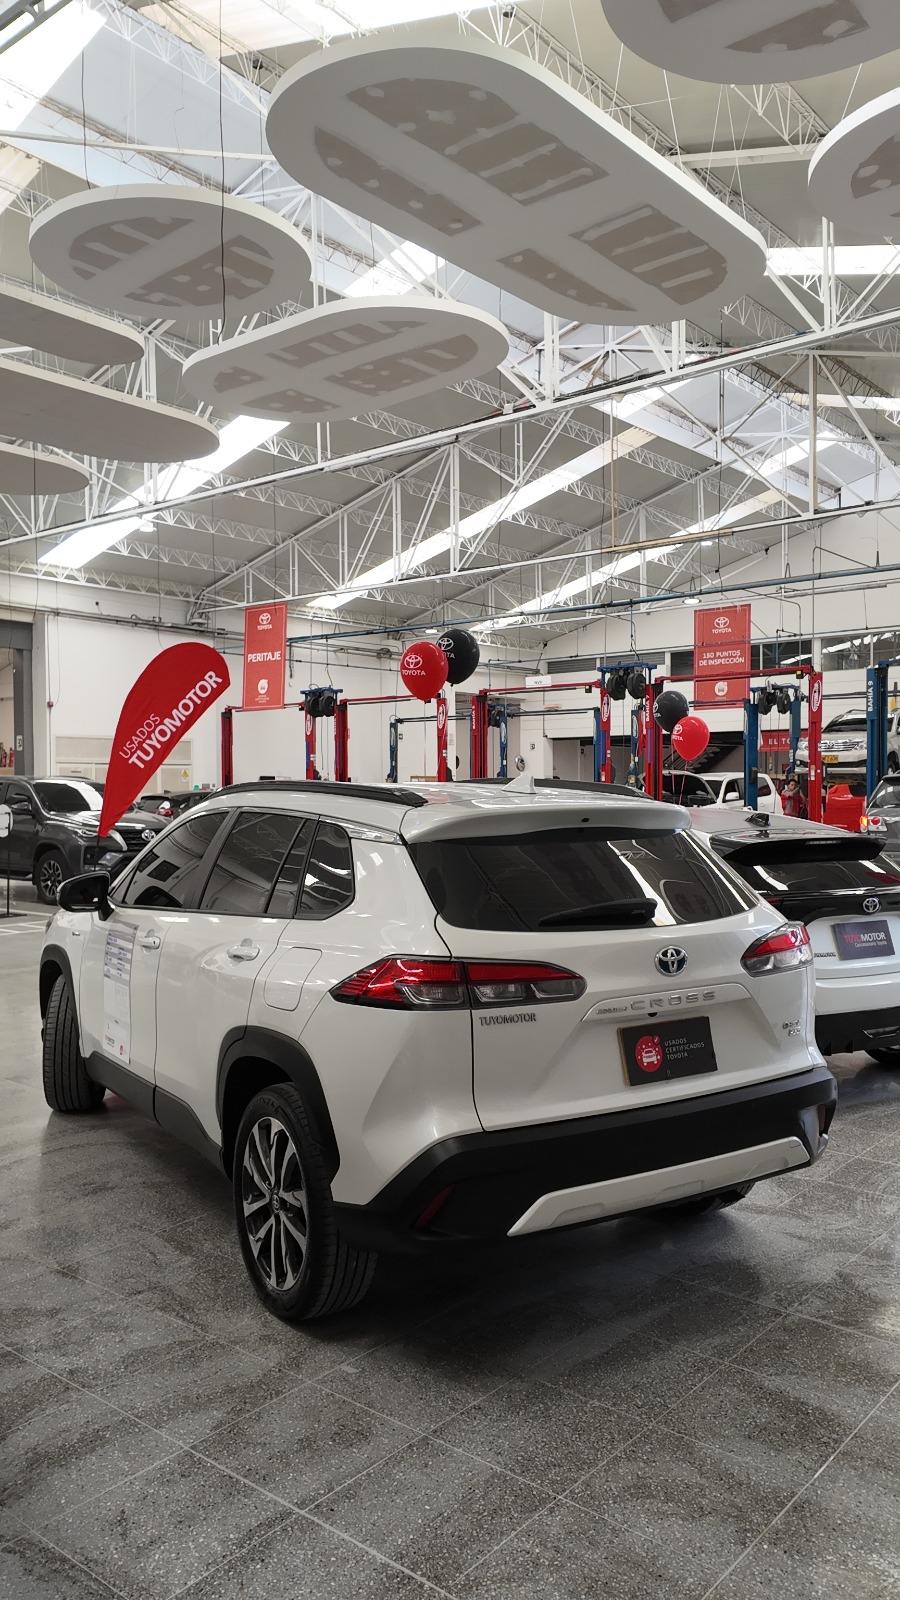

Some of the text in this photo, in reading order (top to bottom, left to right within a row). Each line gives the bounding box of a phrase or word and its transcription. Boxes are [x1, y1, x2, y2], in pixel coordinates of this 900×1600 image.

[247, 651, 281, 662] PERITAJE
[716, 650, 740, 658] PUNTOS
[708, 656, 744, 665] INSPECCIÓN
[128, 671, 223, 769] TUYOMOTOR
[119, 713, 160, 759] USADOS
[844, 932, 886, 943] TUYOMOTOR
[630, 990, 716, 1011] CROSS
[479, 1013, 536, 1026] TUYOMOTOR
[664, 1038, 687, 1047] USADOS
[665, 1041, 705, 1054] CERTIFICADOS
[666, 1052, 689, 1060] TOYOTA
